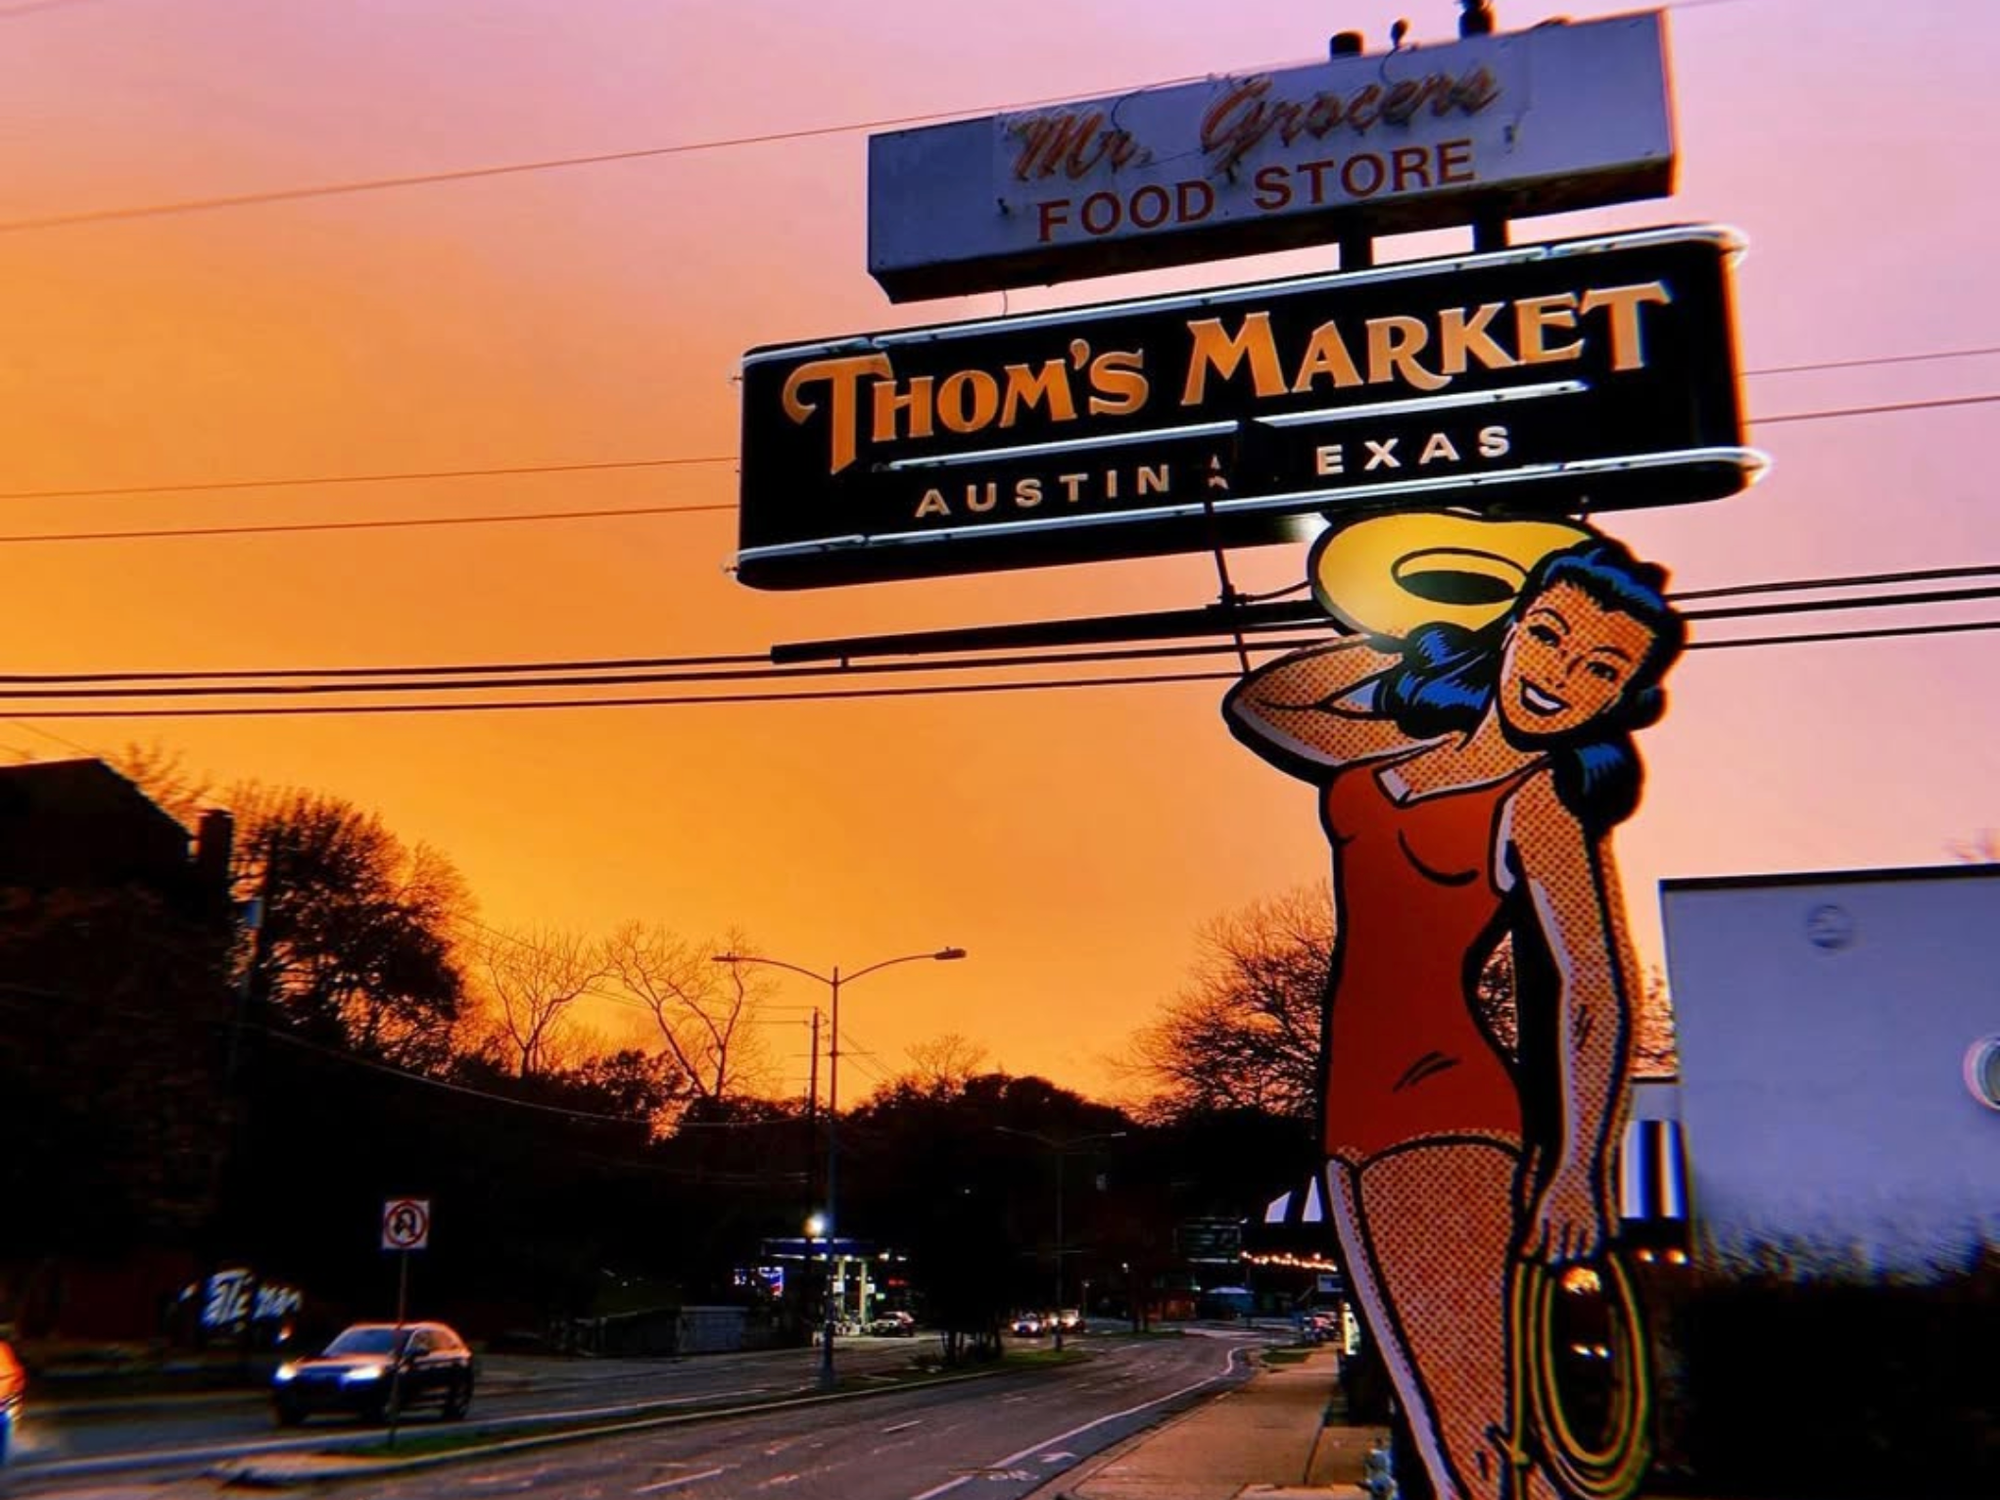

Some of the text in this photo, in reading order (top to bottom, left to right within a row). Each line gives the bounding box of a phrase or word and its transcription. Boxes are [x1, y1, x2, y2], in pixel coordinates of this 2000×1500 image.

[1037, 138, 1475, 242] FOOD STORE
[782, 281, 1671, 475] THOM'S MARKET
[914, 425, 1512, 518] AUSTIN EXAS
